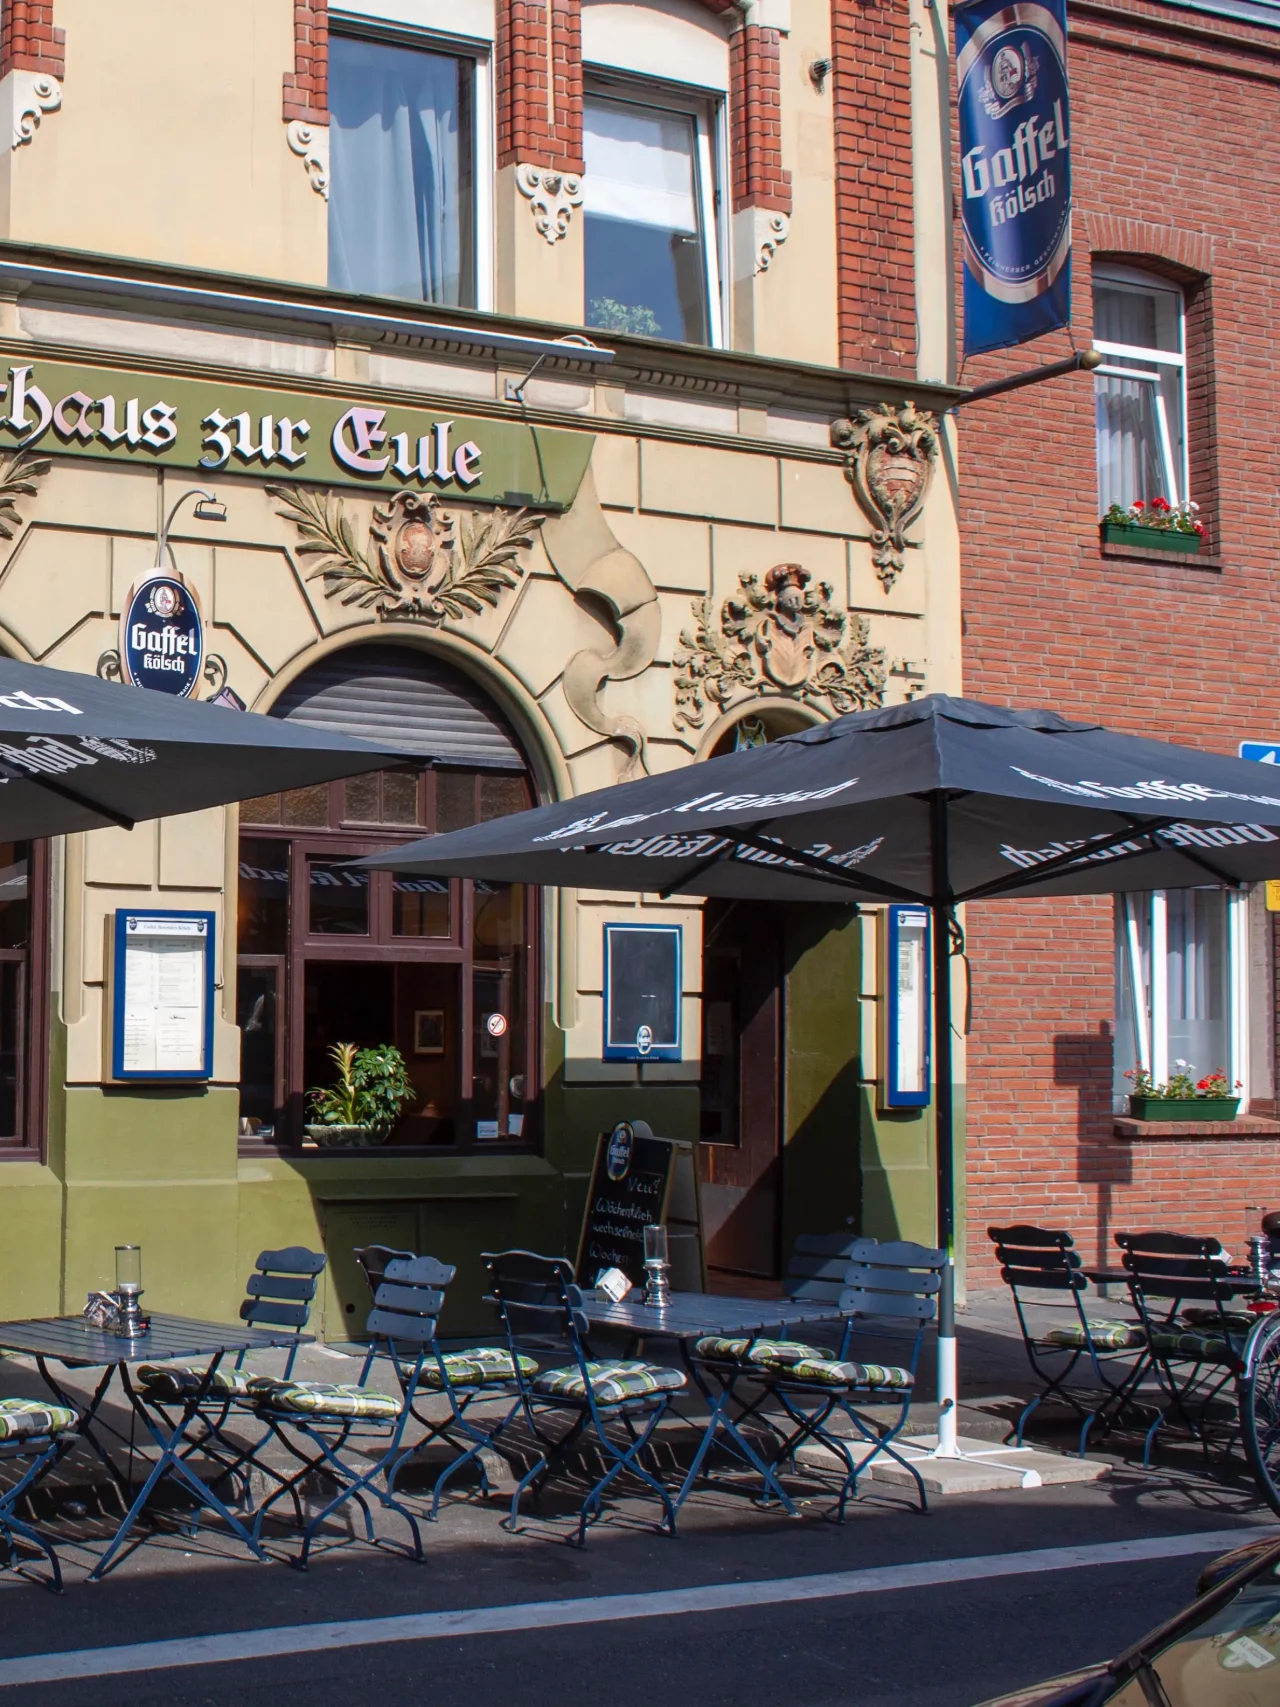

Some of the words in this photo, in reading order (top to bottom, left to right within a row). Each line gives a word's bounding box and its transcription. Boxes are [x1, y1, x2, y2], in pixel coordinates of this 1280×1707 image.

[962, 98, 1069, 199] Gaffel
[989, 168, 1055, 227] Kölsch
[199, 407, 311, 468] zur
[331, 406, 484, 485] Eule
[131, 622, 198, 656] Gaffel
[143, 653, 185, 674] Kölsch
